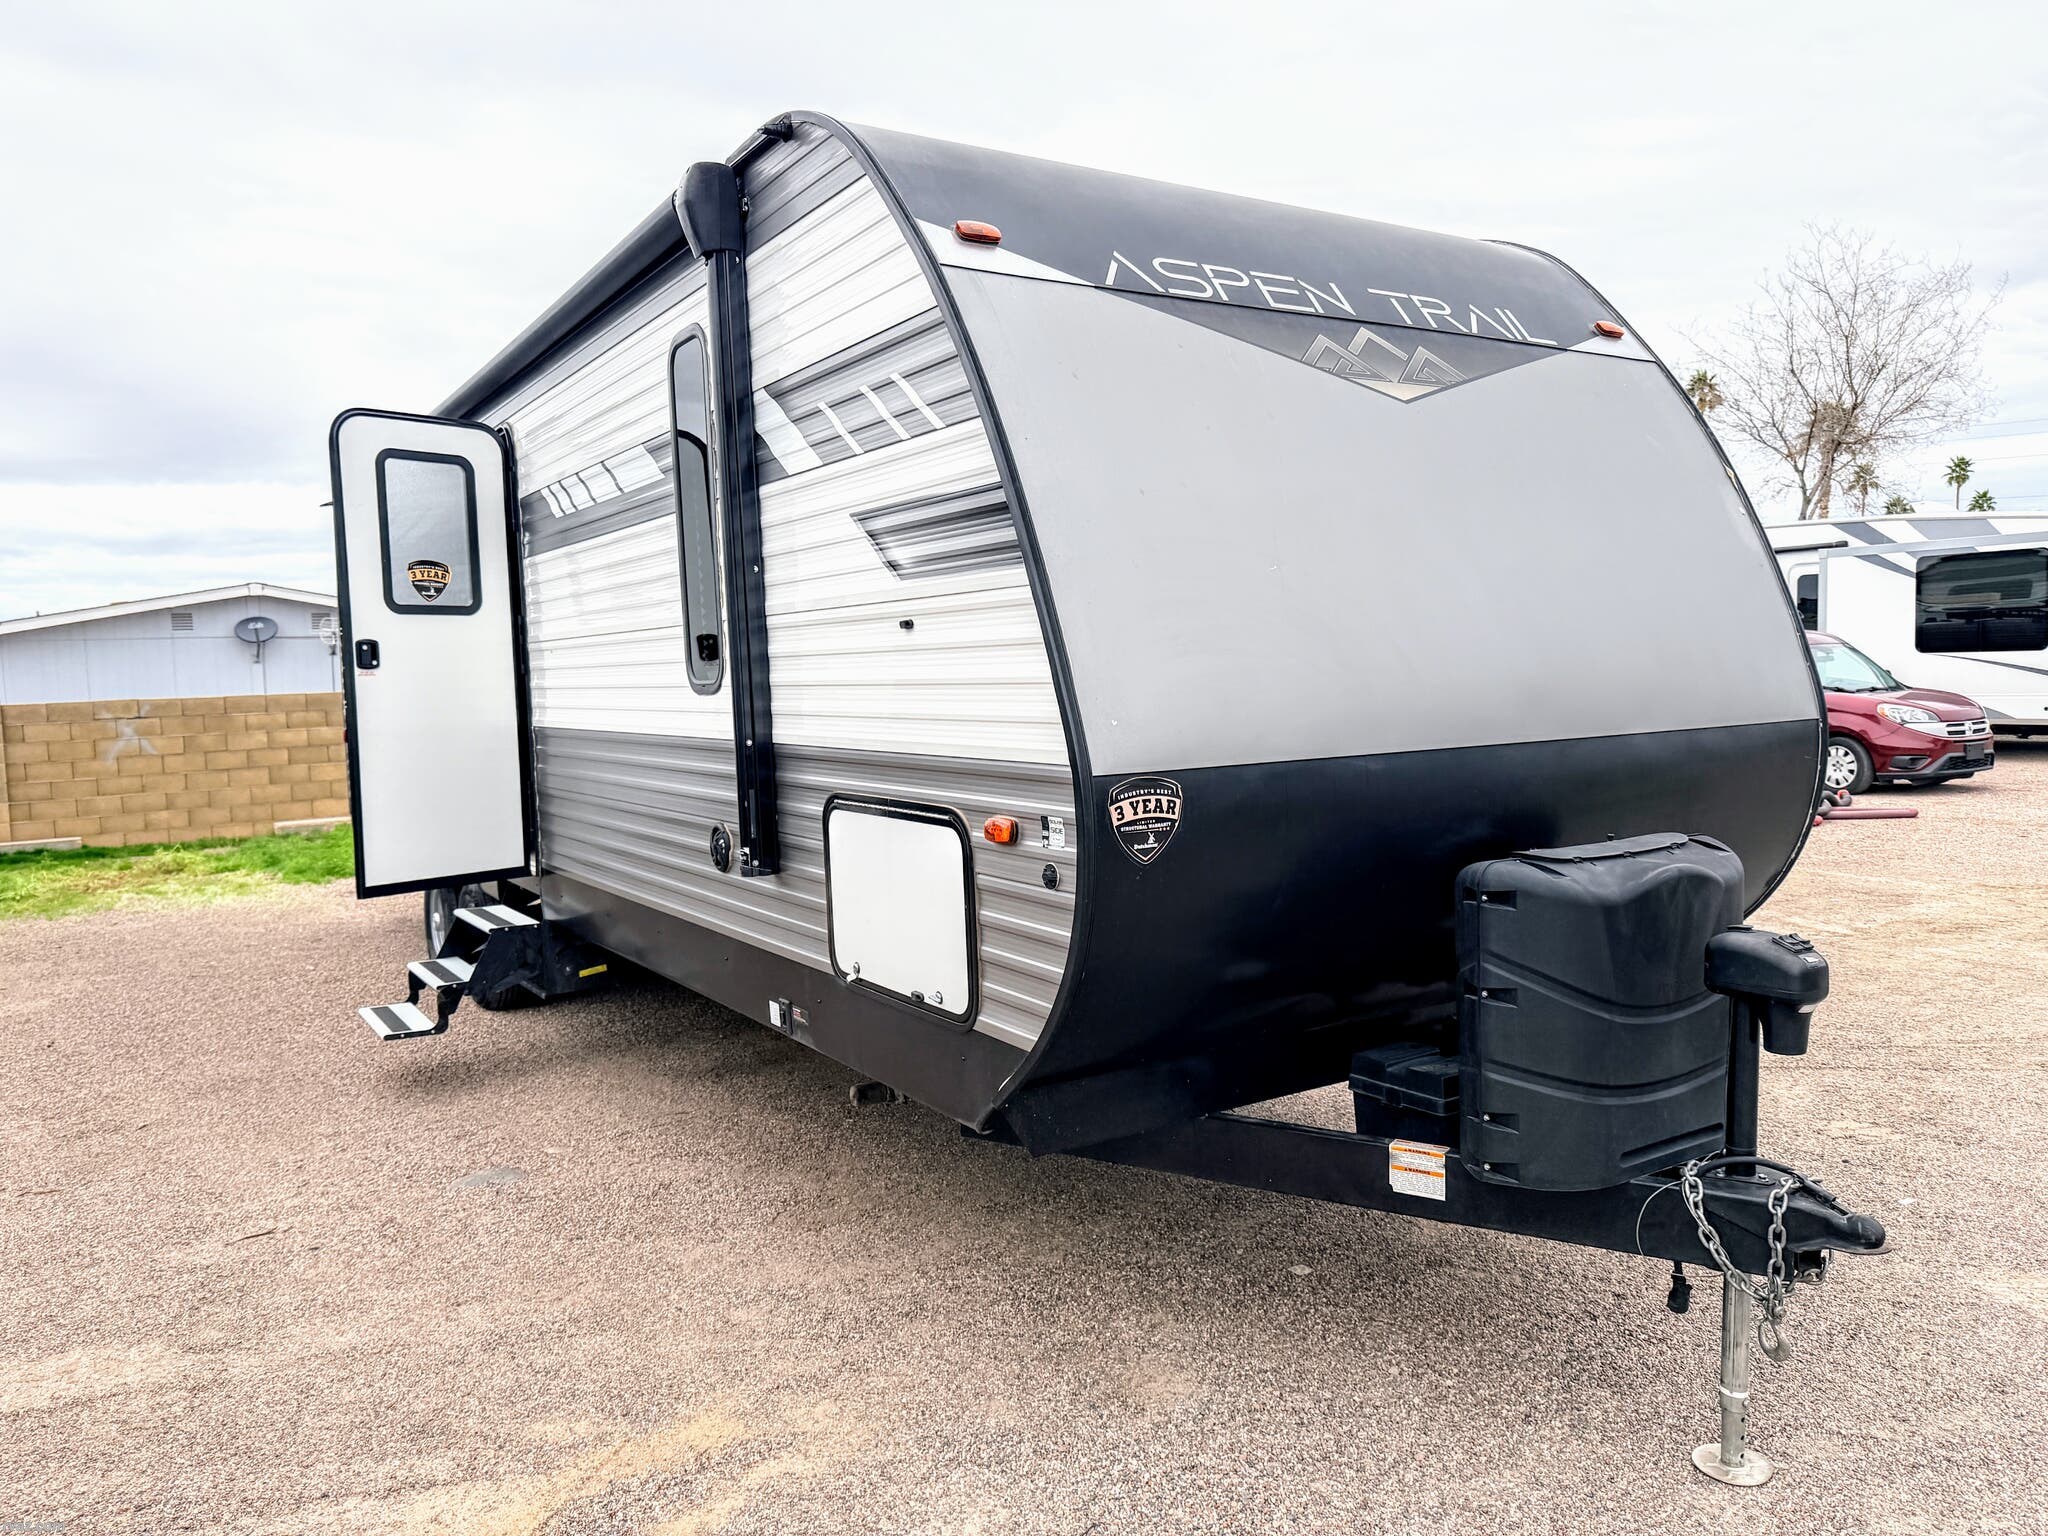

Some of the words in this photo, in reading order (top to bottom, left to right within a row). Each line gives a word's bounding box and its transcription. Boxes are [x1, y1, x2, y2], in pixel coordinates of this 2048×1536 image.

[1105, 250, 1357, 316] ASPEN
[1367, 287, 1558, 346] TRAIL
[410, 571, 417, 579] 3
[419, 570, 447, 581] YEAR
[1114, 805, 1125, 821] 3
[1129, 798, 1177, 816] YEAR
